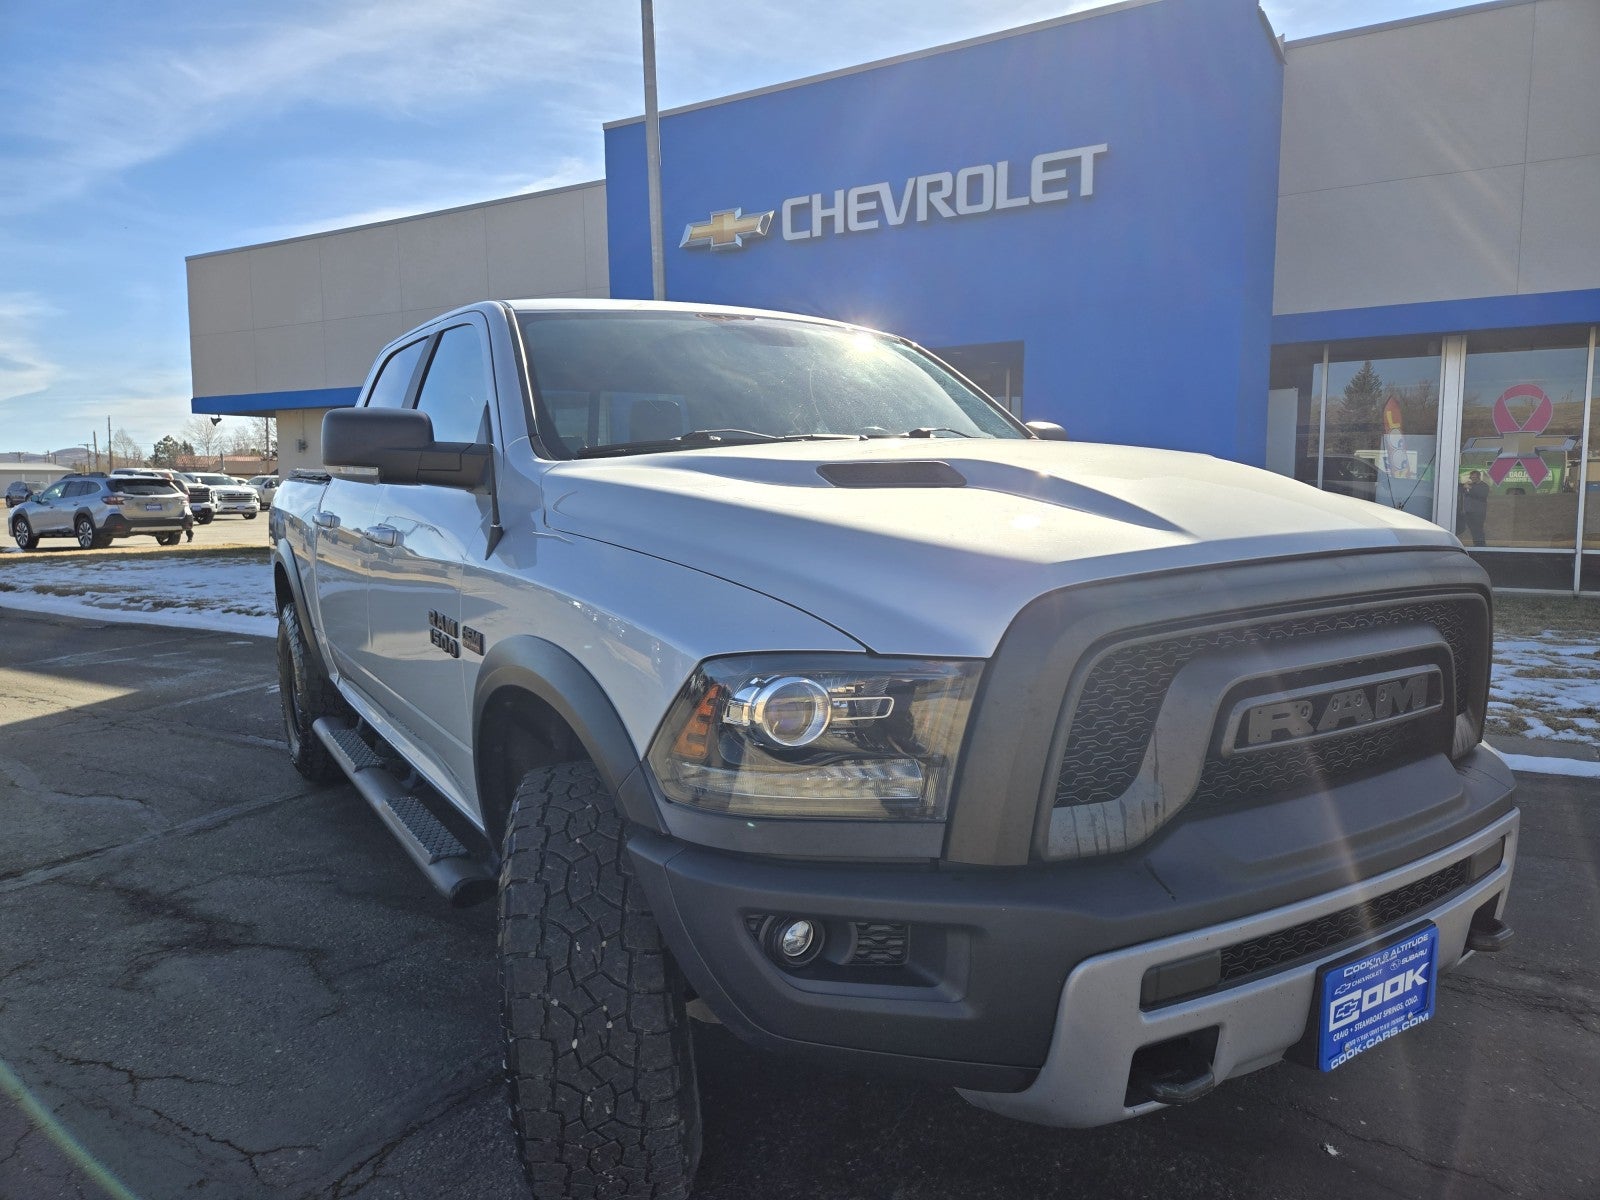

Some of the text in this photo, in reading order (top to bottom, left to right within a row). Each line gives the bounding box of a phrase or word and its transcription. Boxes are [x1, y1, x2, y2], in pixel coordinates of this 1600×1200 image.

[781, 143, 1108, 242] CHEVROLET
[428, 608, 459, 639] RAM
[1247, 672, 1429, 744] RAM
[1390, 933, 1429, 958] ALTITUDE
[1401, 948, 1428, 965] SUBARU
[1351, 968, 1383, 987] CHEVROLET
[1328, 961, 1430, 1033] COOK
[1332, 1030, 1349, 1042] CRAIG
[1354, 1012, 1383, 1032] STEAMBOAT
